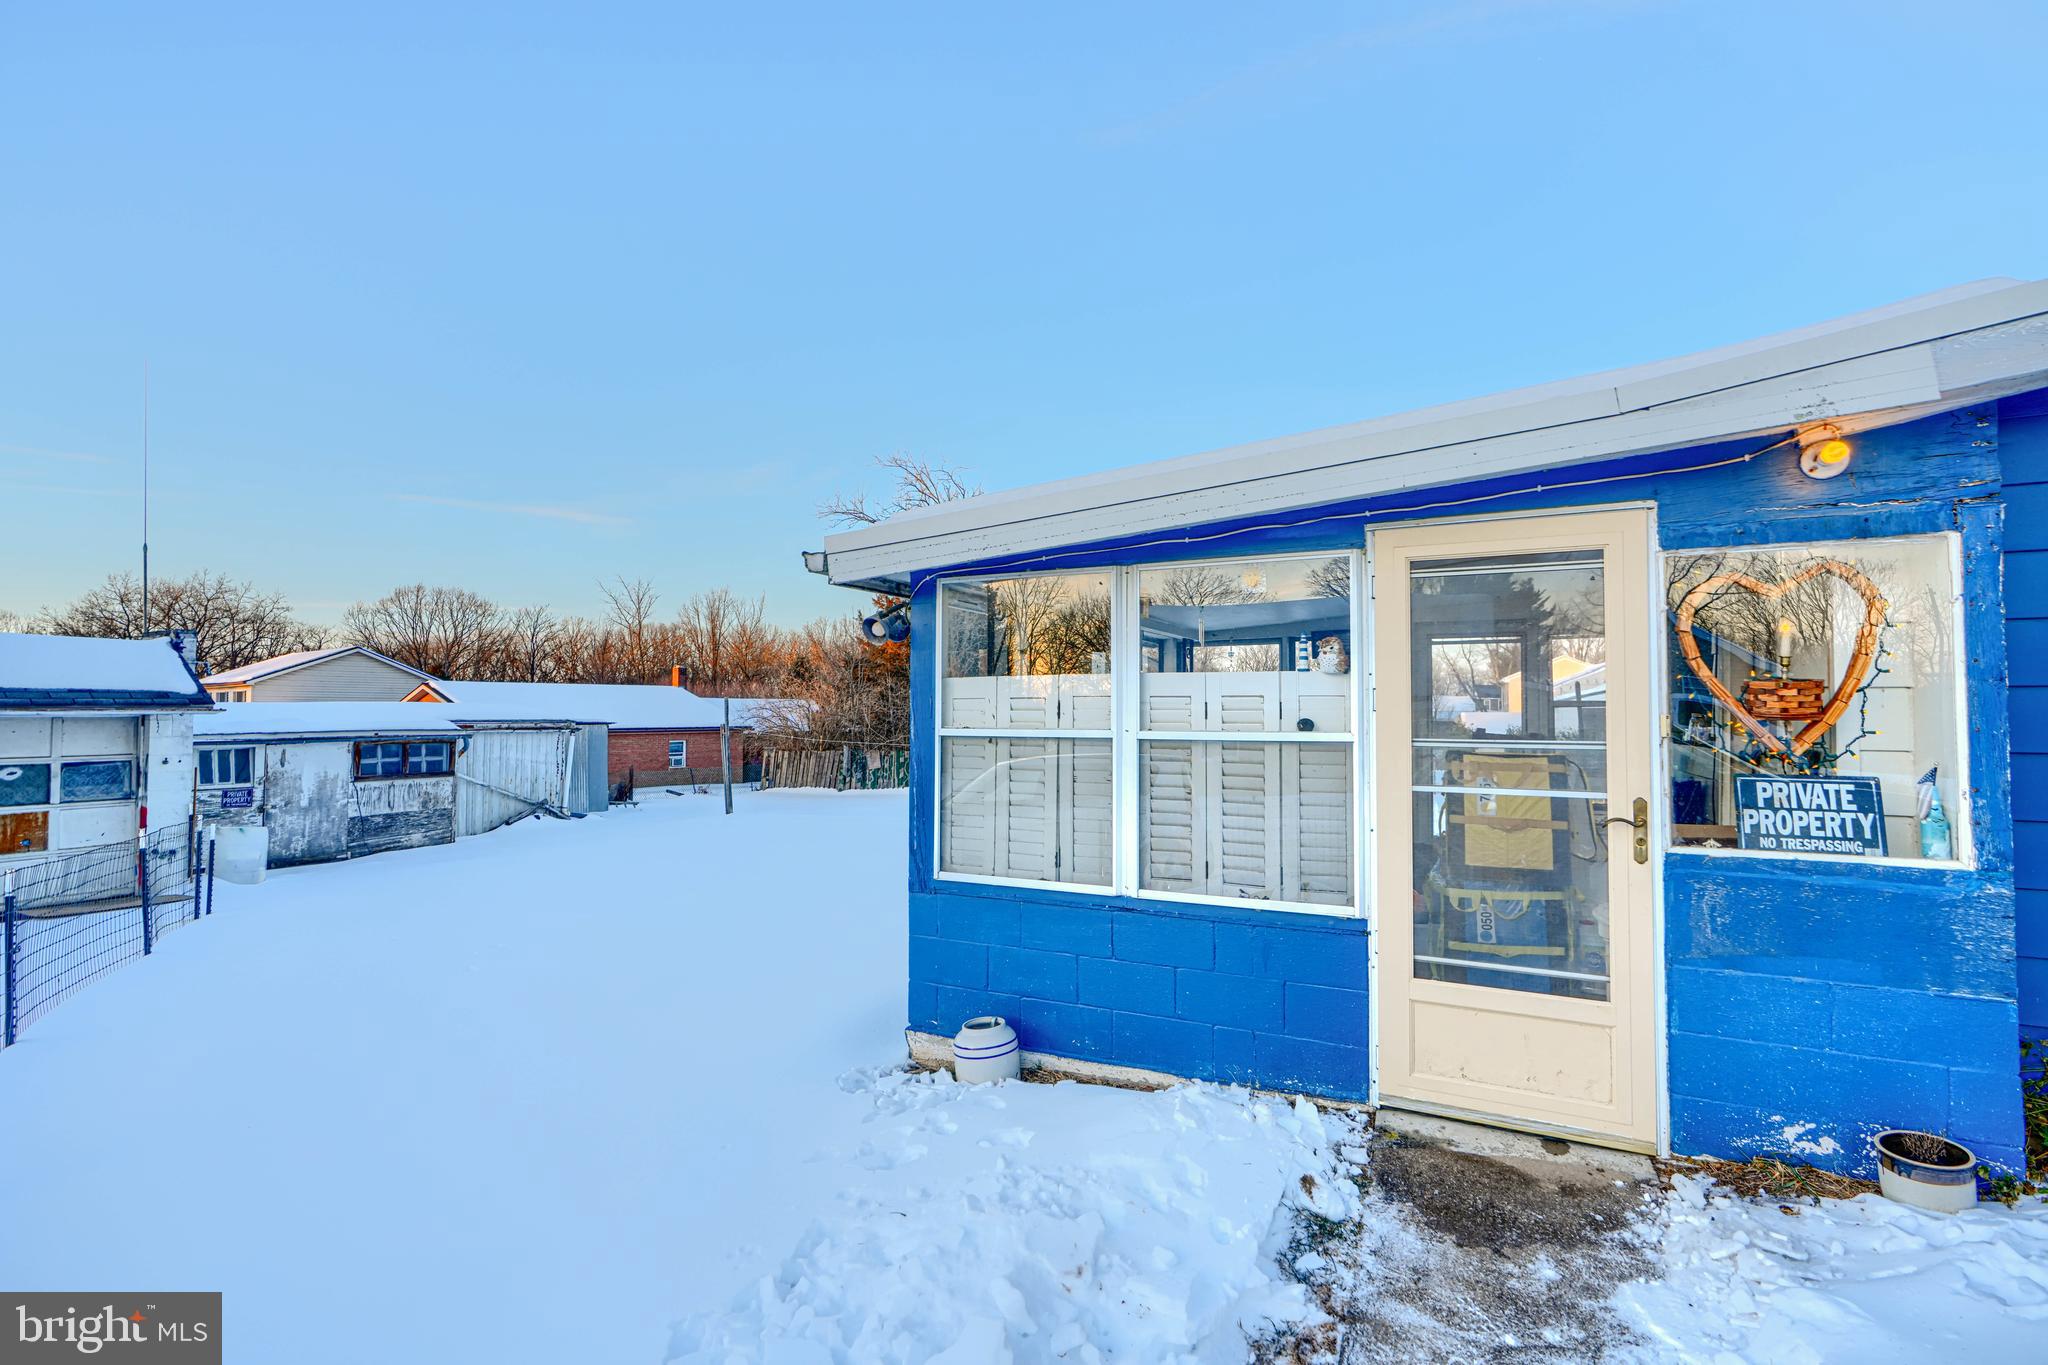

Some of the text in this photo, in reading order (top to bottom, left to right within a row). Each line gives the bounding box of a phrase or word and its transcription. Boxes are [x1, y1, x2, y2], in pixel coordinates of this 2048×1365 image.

[1756, 781, 1858, 811] PRIVATE
[1743, 808, 1876, 840] PROPERTY
[1759, 836, 1864, 854] NO TRESPASSING
[1480, 911, 1493, 931] 050
